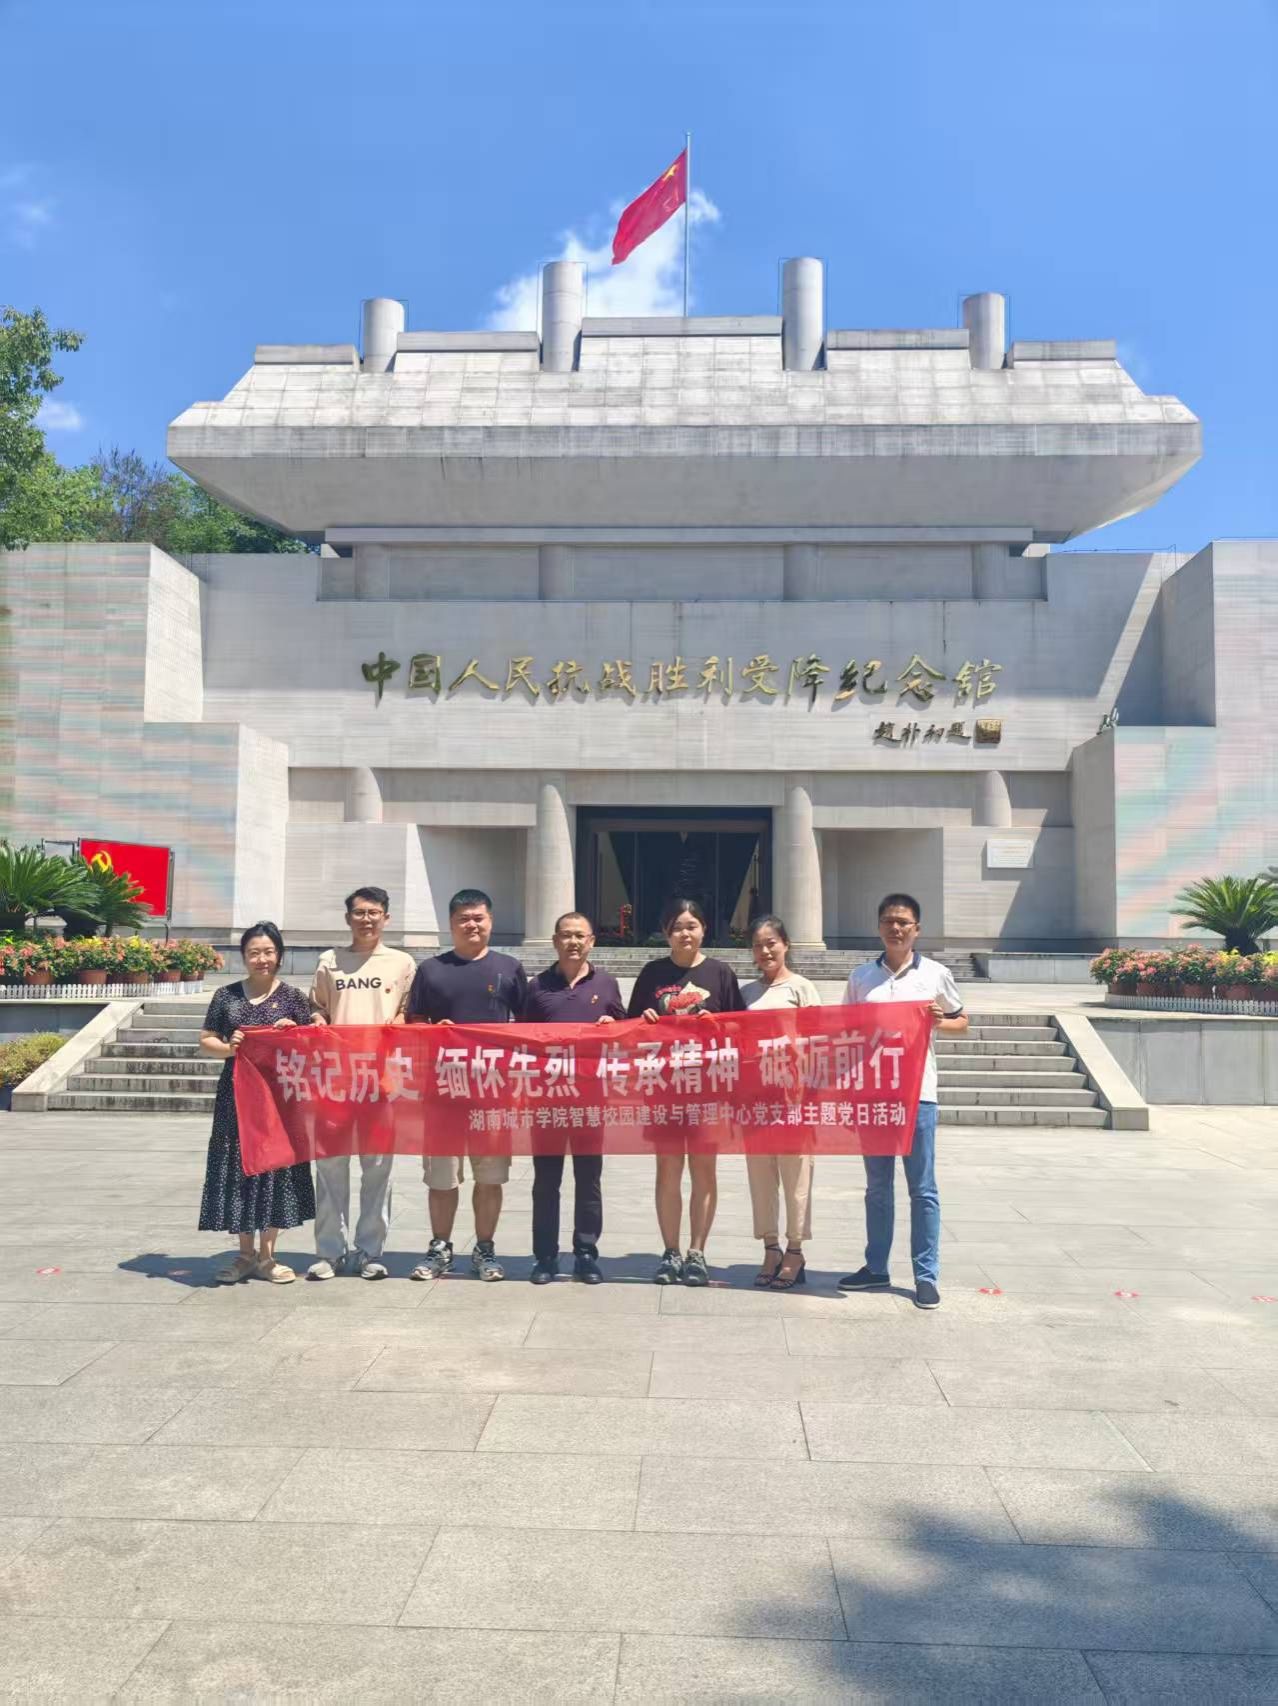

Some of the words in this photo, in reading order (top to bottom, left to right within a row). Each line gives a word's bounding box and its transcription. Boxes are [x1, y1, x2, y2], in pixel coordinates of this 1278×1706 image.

[335, 977, 382, 991] BANG
[275, 1047, 420, 1103] 铭记历史
[435, 1044, 580, 1099] 缅怀先烈
[595, 1036, 740, 1097] 传承精神
[757, 1028, 906, 1091] 砥砺前行
[468, 1101, 907, 1132] 湖南城市学院智慧校园建设与管理中心党支部主题党日活动
